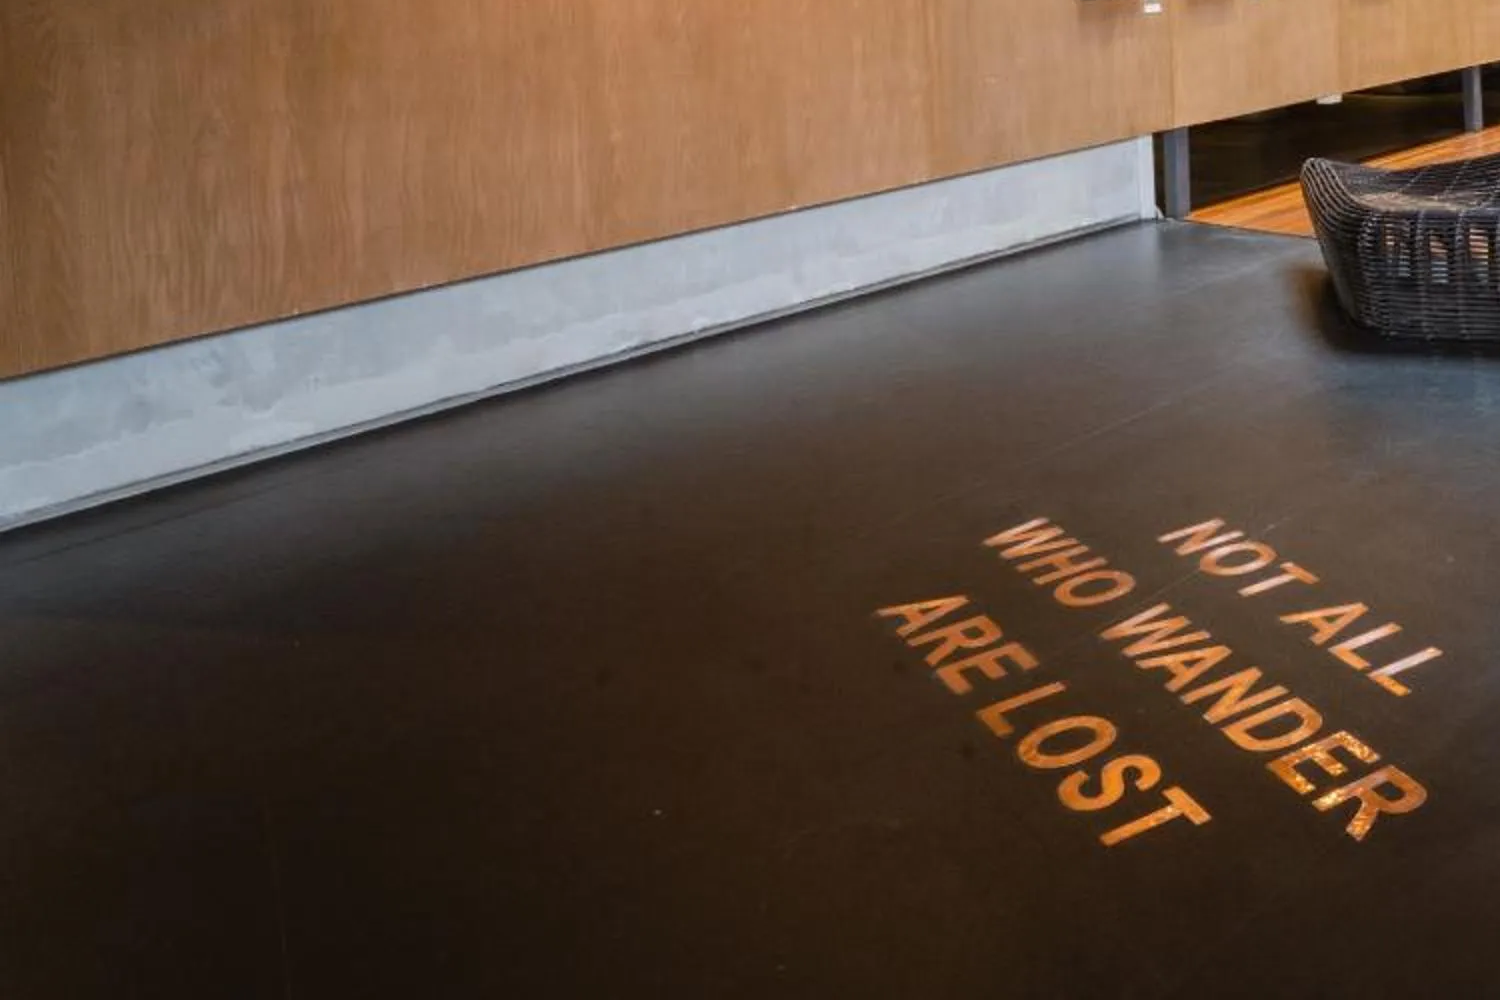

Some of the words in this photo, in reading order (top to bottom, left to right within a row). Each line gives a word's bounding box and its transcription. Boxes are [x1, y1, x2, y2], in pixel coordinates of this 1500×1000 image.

[875, 594, 1039, 695] ARE
[976, 680, 1213, 847] LOST
[982, 516, 1137, 608] WHO
[1099, 601, 1429, 842] WANDER
[1157, 516, 1321, 598] NOT
[1278, 600, 1444, 697] ALL
